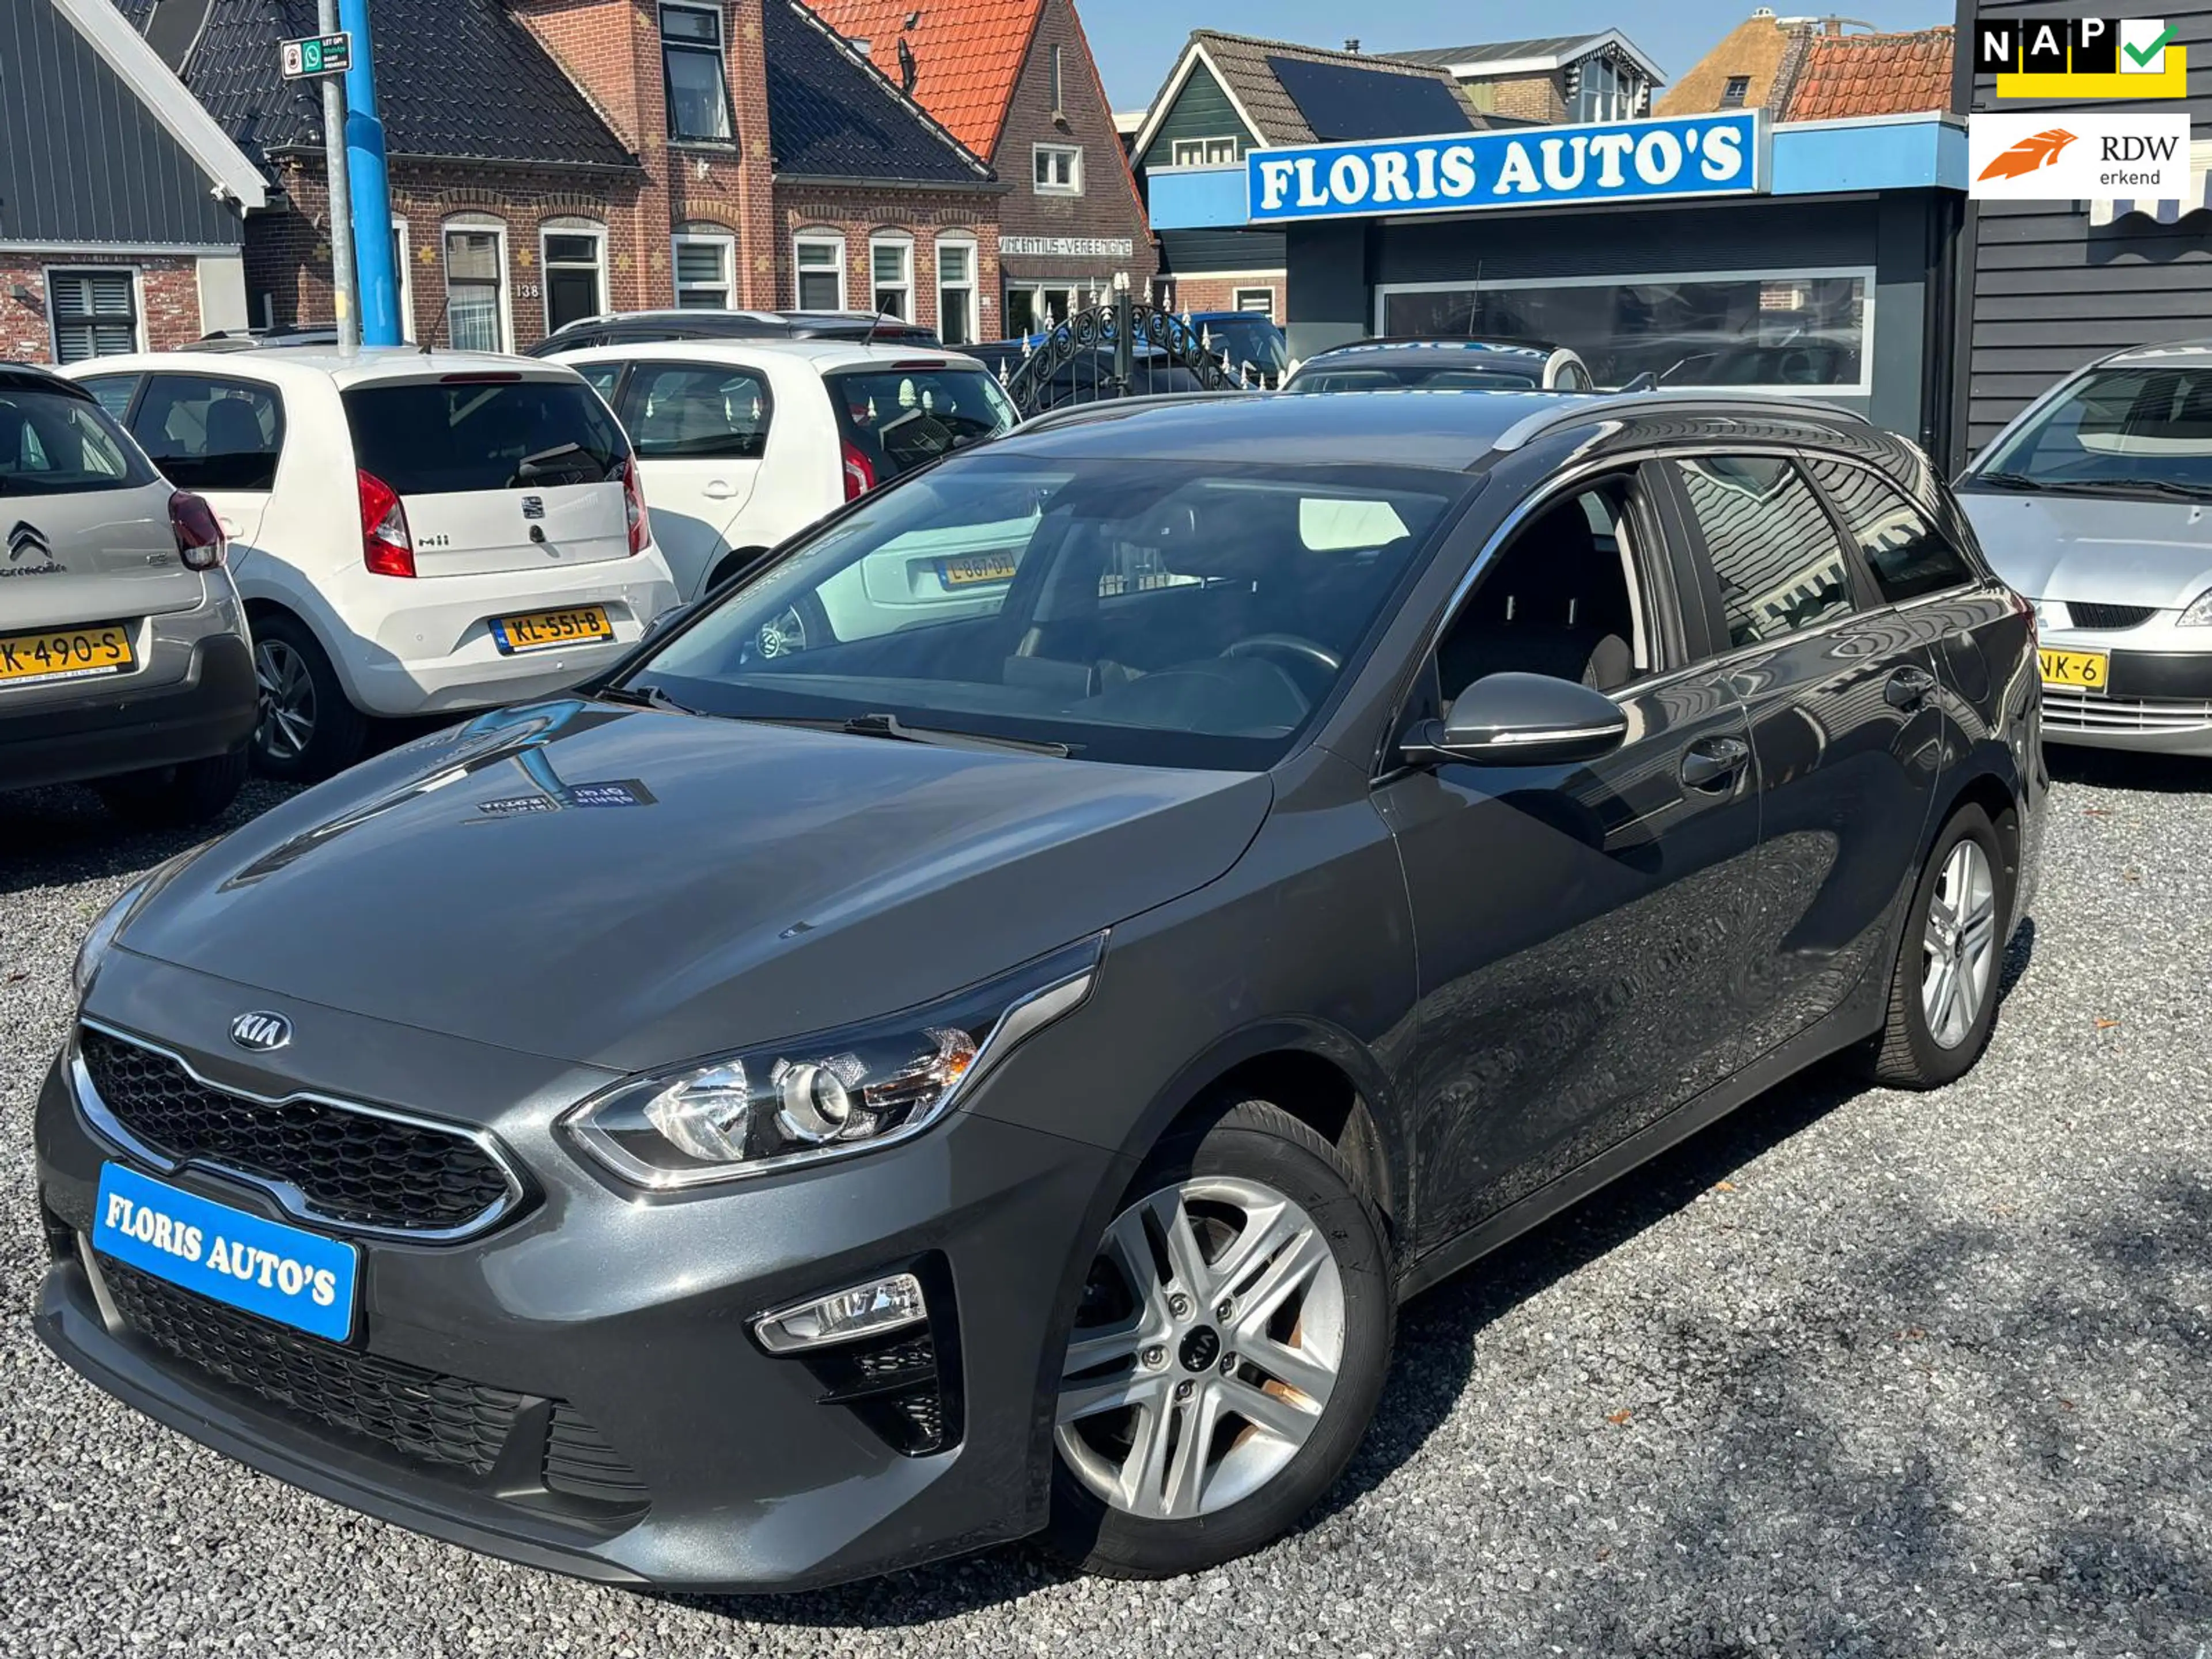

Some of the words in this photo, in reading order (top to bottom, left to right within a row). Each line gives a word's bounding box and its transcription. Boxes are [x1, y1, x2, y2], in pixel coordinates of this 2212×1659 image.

[1259, 145, 1477, 210] FLORIS
[1493, 125, 1743, 195] AUTO'S
[517, 284, 539, 298] 138
[511, 612, 601, 641] KL-551-B
[0, 632, 120, 673] K-490-S
[233, 1014, 281, 1047] KIA
[105, 1192, 203, 1262] FLORIS
[206, 1235, 336, 1306] AUTO'S
